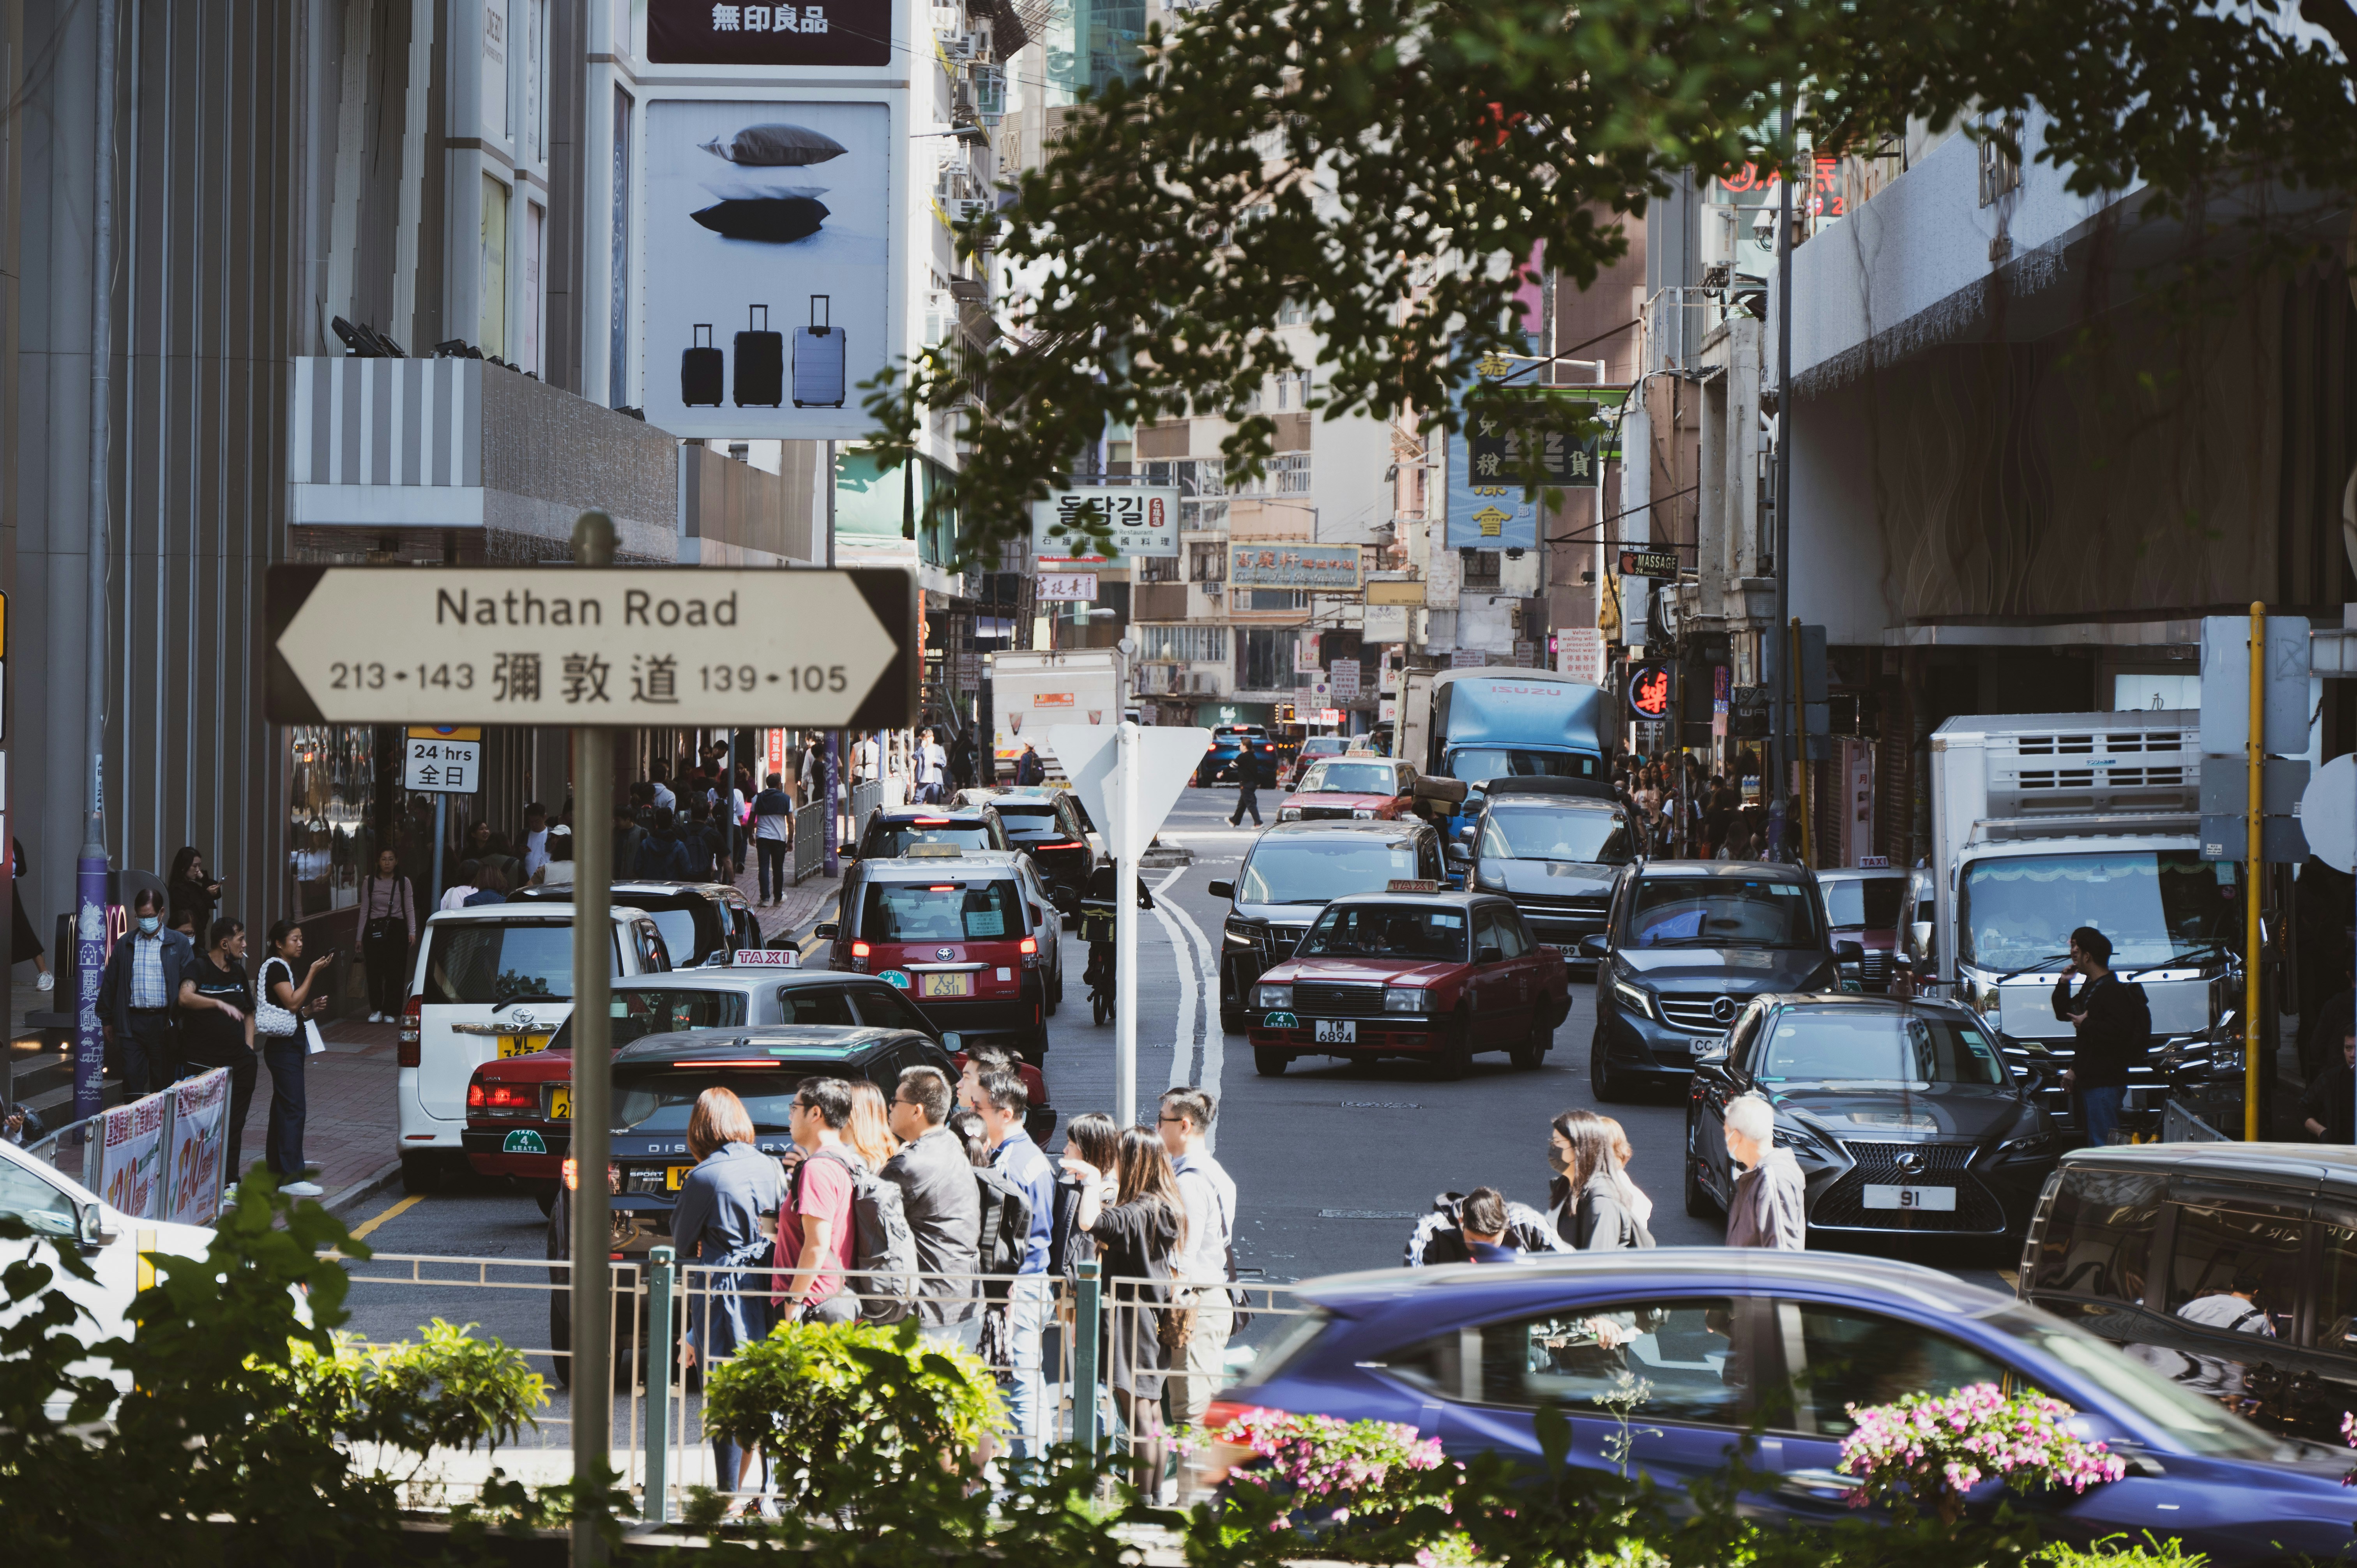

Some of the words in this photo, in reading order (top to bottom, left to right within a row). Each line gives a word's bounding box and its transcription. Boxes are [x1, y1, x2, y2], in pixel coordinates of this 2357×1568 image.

[712, 3, 828, 33] 無印良品
[1057, 496, 1143, 526] 돌담길
[1638, 554, 1676, 569] MASSAGE
[1235, 570, 1268, 581] Korea
[1270, 571, 1291, 582] Inn
[1293, 571, 1355, 584] Restaurant
[436, 586, 603, 626] Nathan
[625, 588, 739, 627] Road
[330, 662, 386, 691] 213
[418, 662, 474, 691] 143
[492, 652, 680, 705] 彌敦道
[701, 664, 756, 692] 139
[789, 665, 847, 693] 105
[1492, 686, 1561, 696] ISUZU
[414, 744, 438, 759] 24
[445, 746, 472, 761] hrs
[419, 764, 463, 786] 全日
[913, 845, 957, 854] TAXI
[1863, 858, 1886, 866] TAXI
[1391, 880, 1434, 890] TAXI
[738, 951, 790, 964] TAXI
[938, 975, 955, 986] XJ
[934, 985, 959, 995] 6311
[1327, 1021, 1345, 1031] TM
[513, 1036, 534, 1050] WL
[1319, 1031, 1352, 1042] 6894
[520, 1136, 528, 1145] 4
[1901, 1191, 1919, 1206] 91
